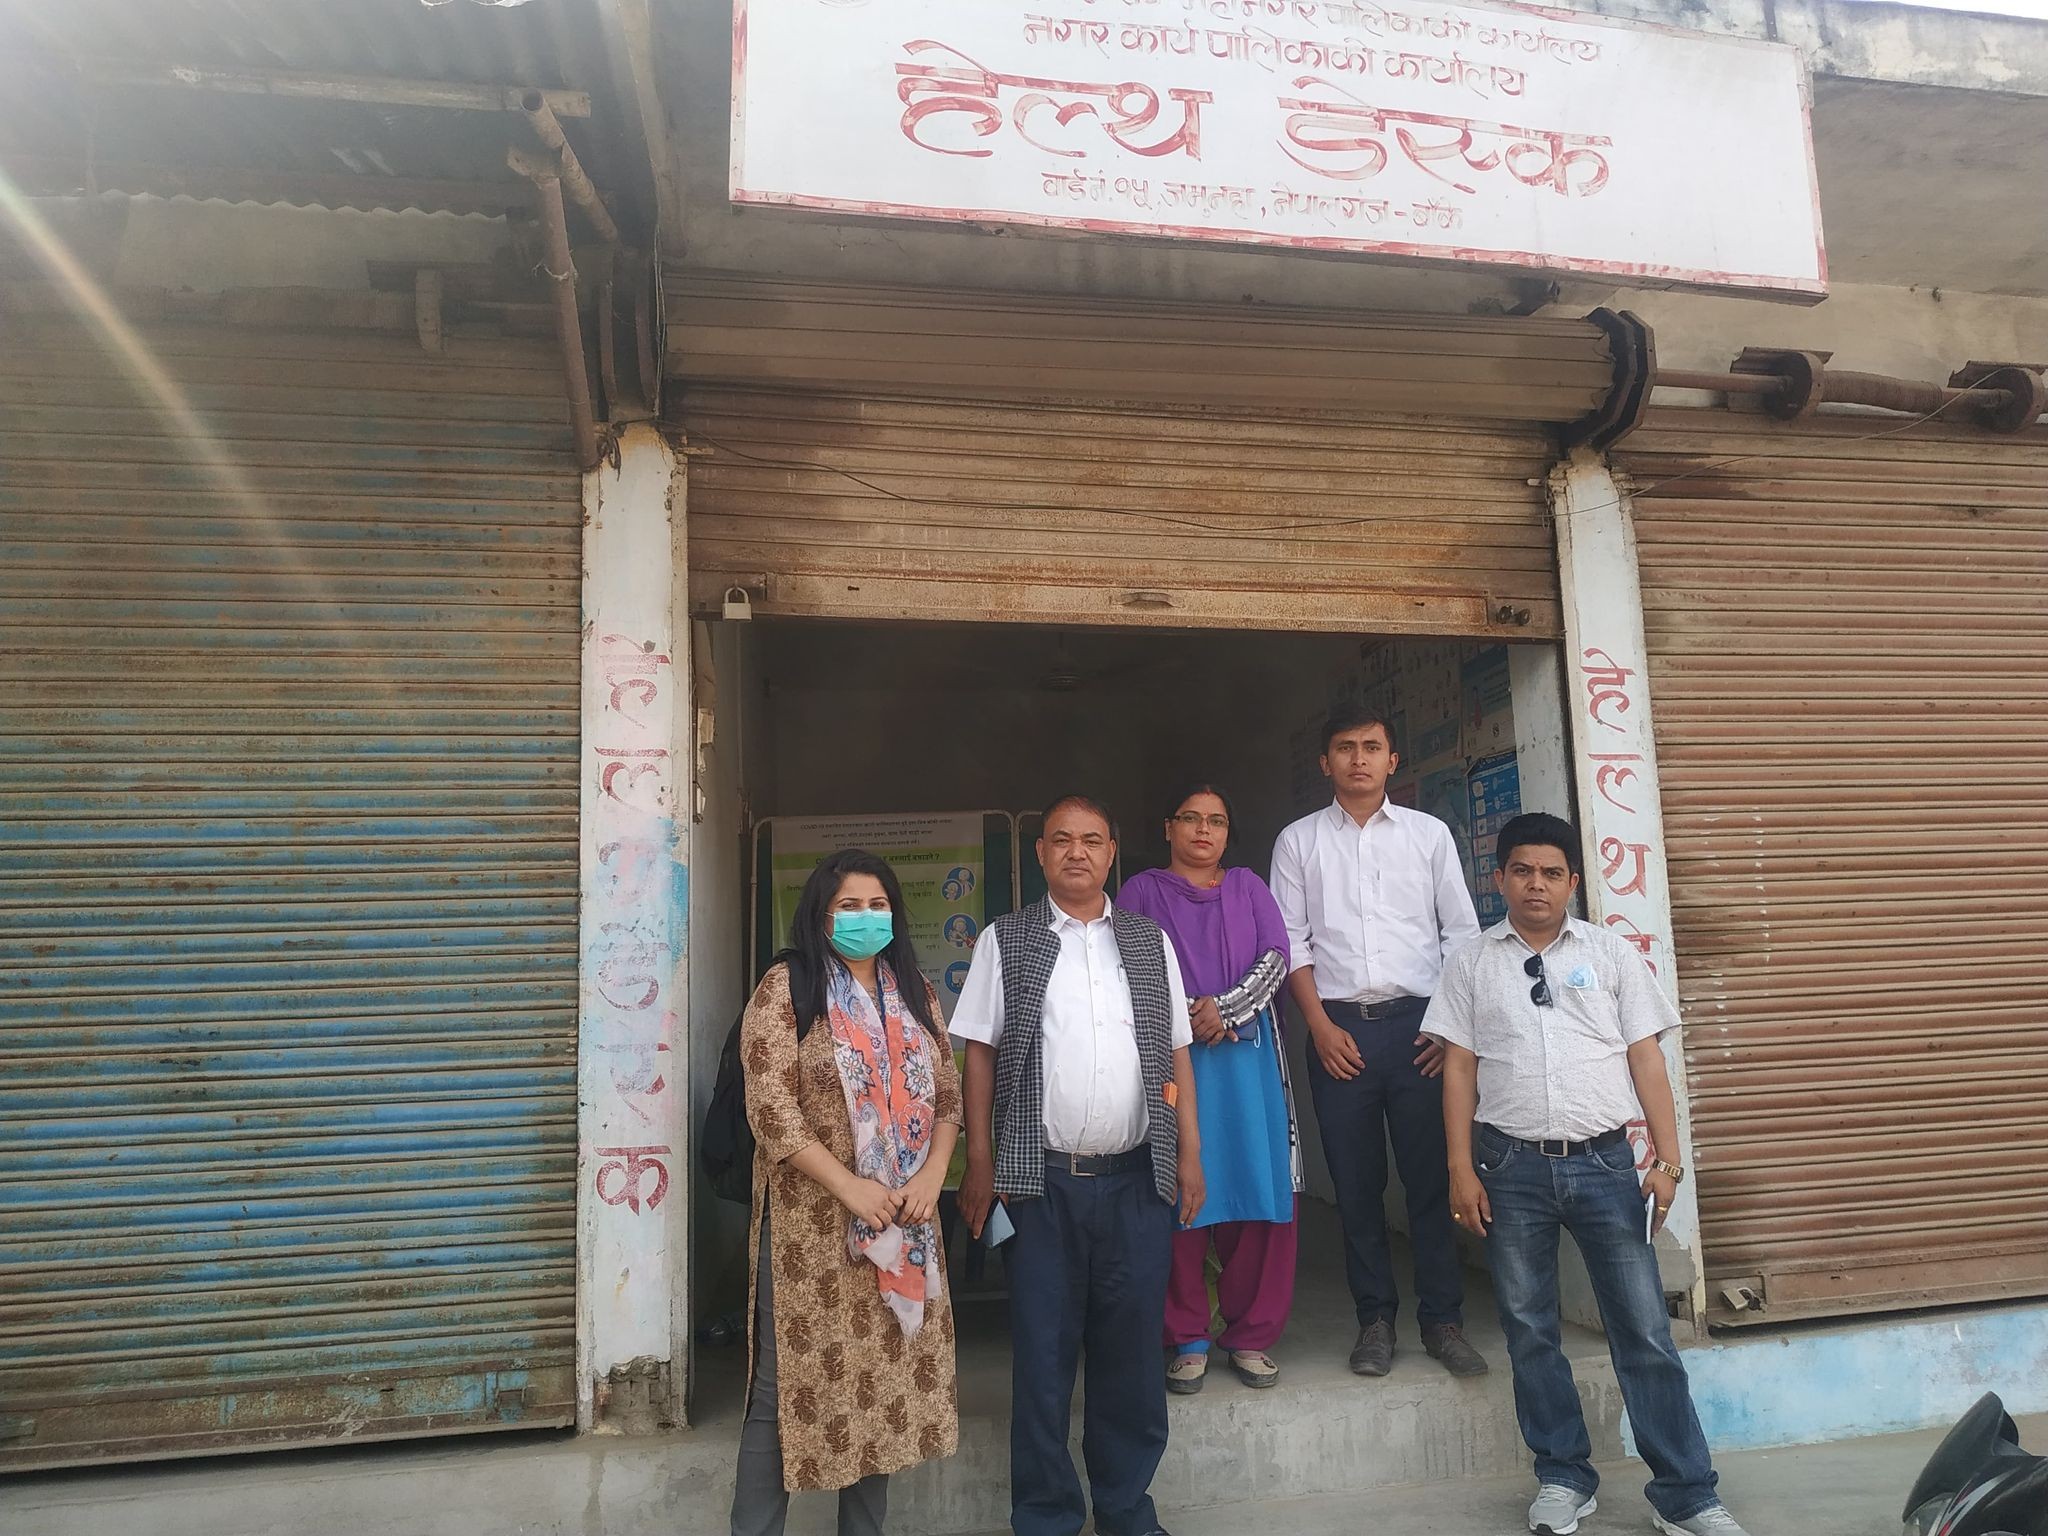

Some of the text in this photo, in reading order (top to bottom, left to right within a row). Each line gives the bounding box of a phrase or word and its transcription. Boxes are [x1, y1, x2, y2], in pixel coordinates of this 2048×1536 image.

[1024, 13, 1114, 59] नगर
[894, 39, 1613, 197] हेल्थ डेस्क
